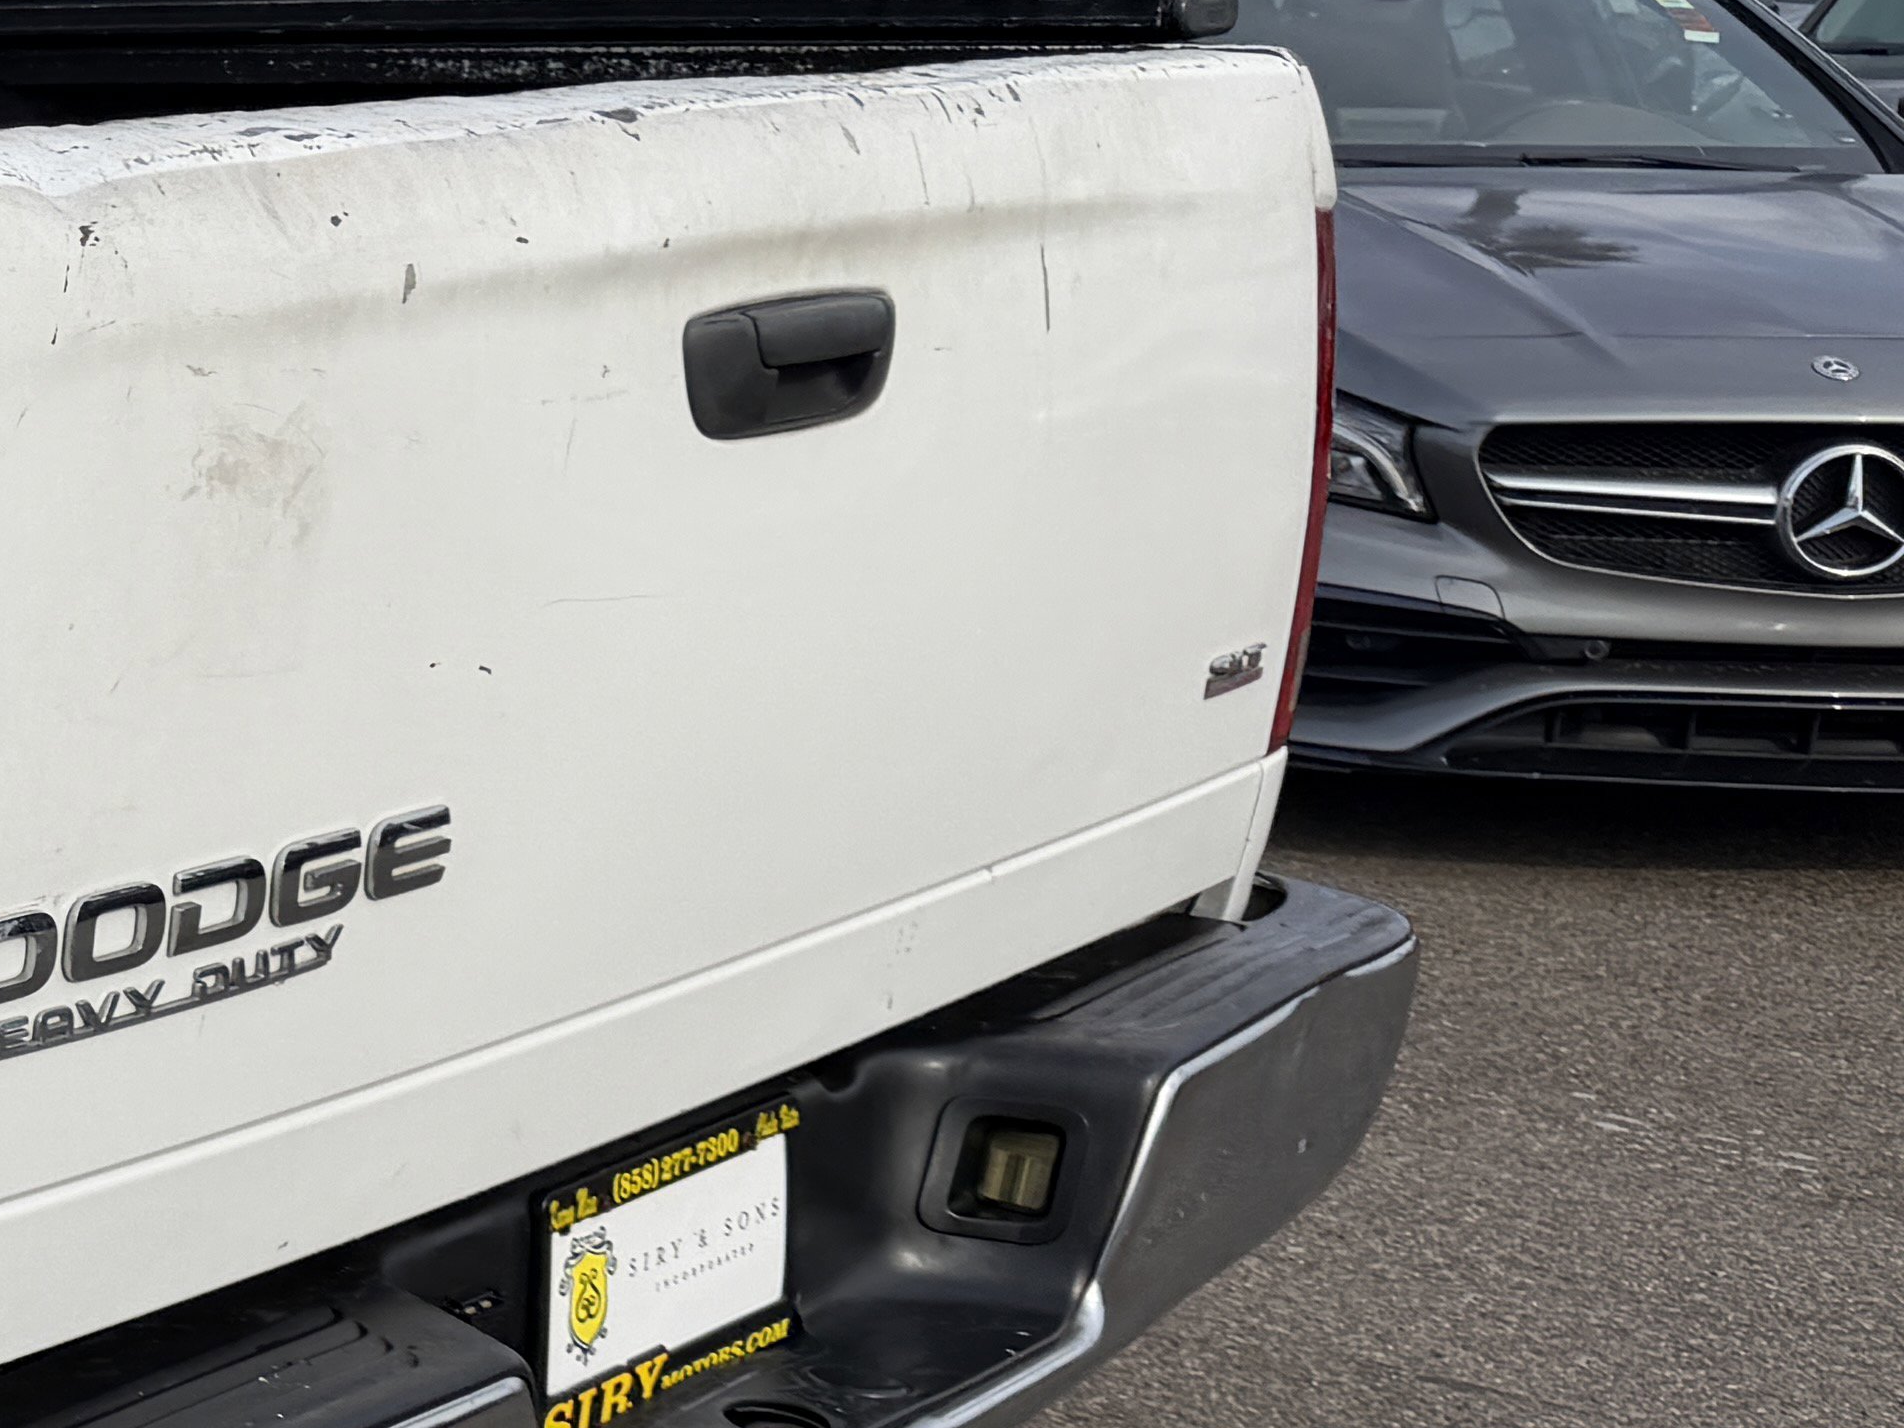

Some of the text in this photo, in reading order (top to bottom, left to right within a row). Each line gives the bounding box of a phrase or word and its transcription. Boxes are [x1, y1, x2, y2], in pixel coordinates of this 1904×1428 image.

[191, 922, 345, 1004] DUTY
[612, 1157, 660, 1204] (858)
[629, 1237, 683, 1278] SIRY
[724, 1196, 780, 1238] SONS
[660, 1317, 791, 1390] MOTORS.COM
